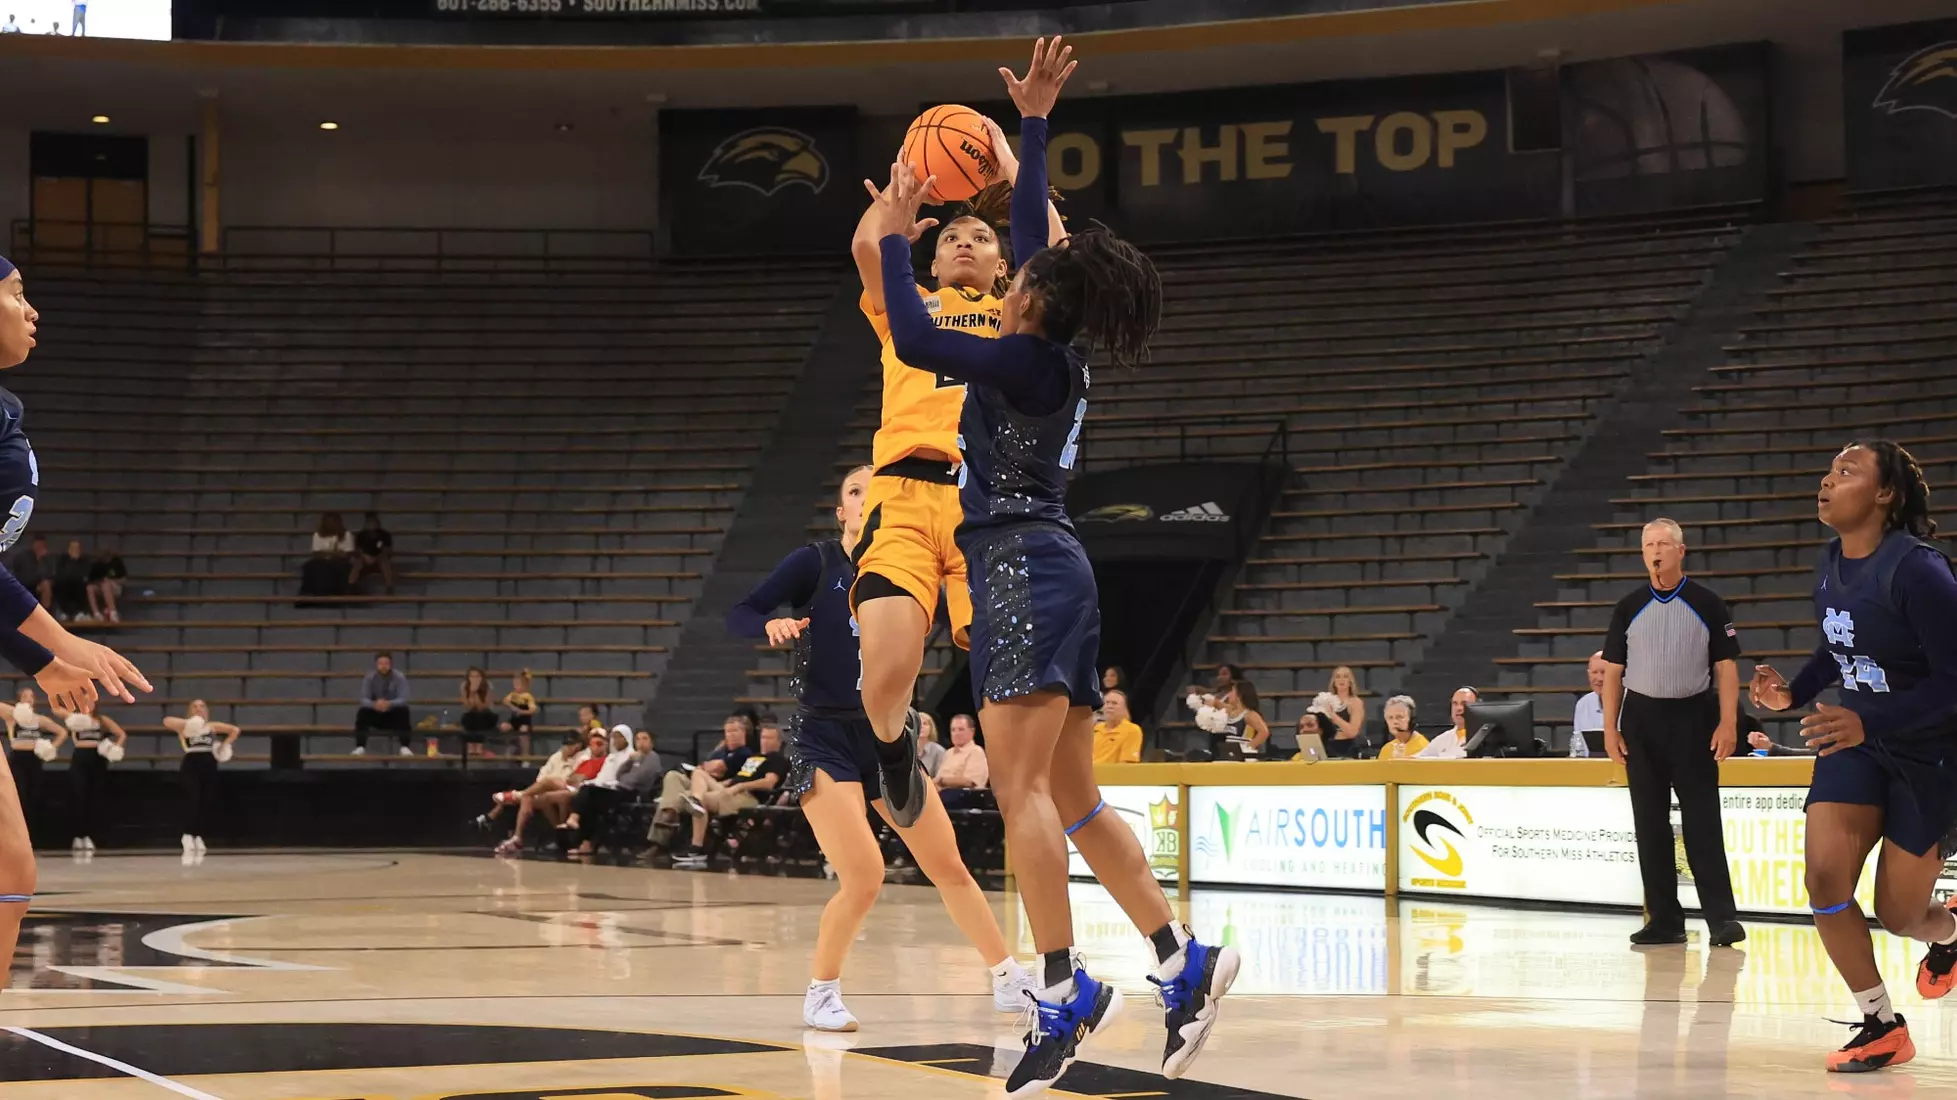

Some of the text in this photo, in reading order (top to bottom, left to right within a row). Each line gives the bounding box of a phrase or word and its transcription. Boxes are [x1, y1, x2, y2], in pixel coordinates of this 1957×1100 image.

[1121, 120, 1296, 186] THE
[1314, 110, 1487, 175] TOP
[1160, 512, 1230, 522] adidas
[1722, 794, 1752, 809] entire
[1755, 795, 1773, 812] app
[1245, 808, 1386, 849] AIRSOUTH
[1477, 826, 1515, 839] OFFICIAL
[1516, 826, 1551, 841] SPORTS
[1552, 828, 1597, 842] MEDICINE
[1492, 845, 1635, 863] FOR SOUTHERN MISS ATHLETICS
[1302, 861, 1326, 874] AND
